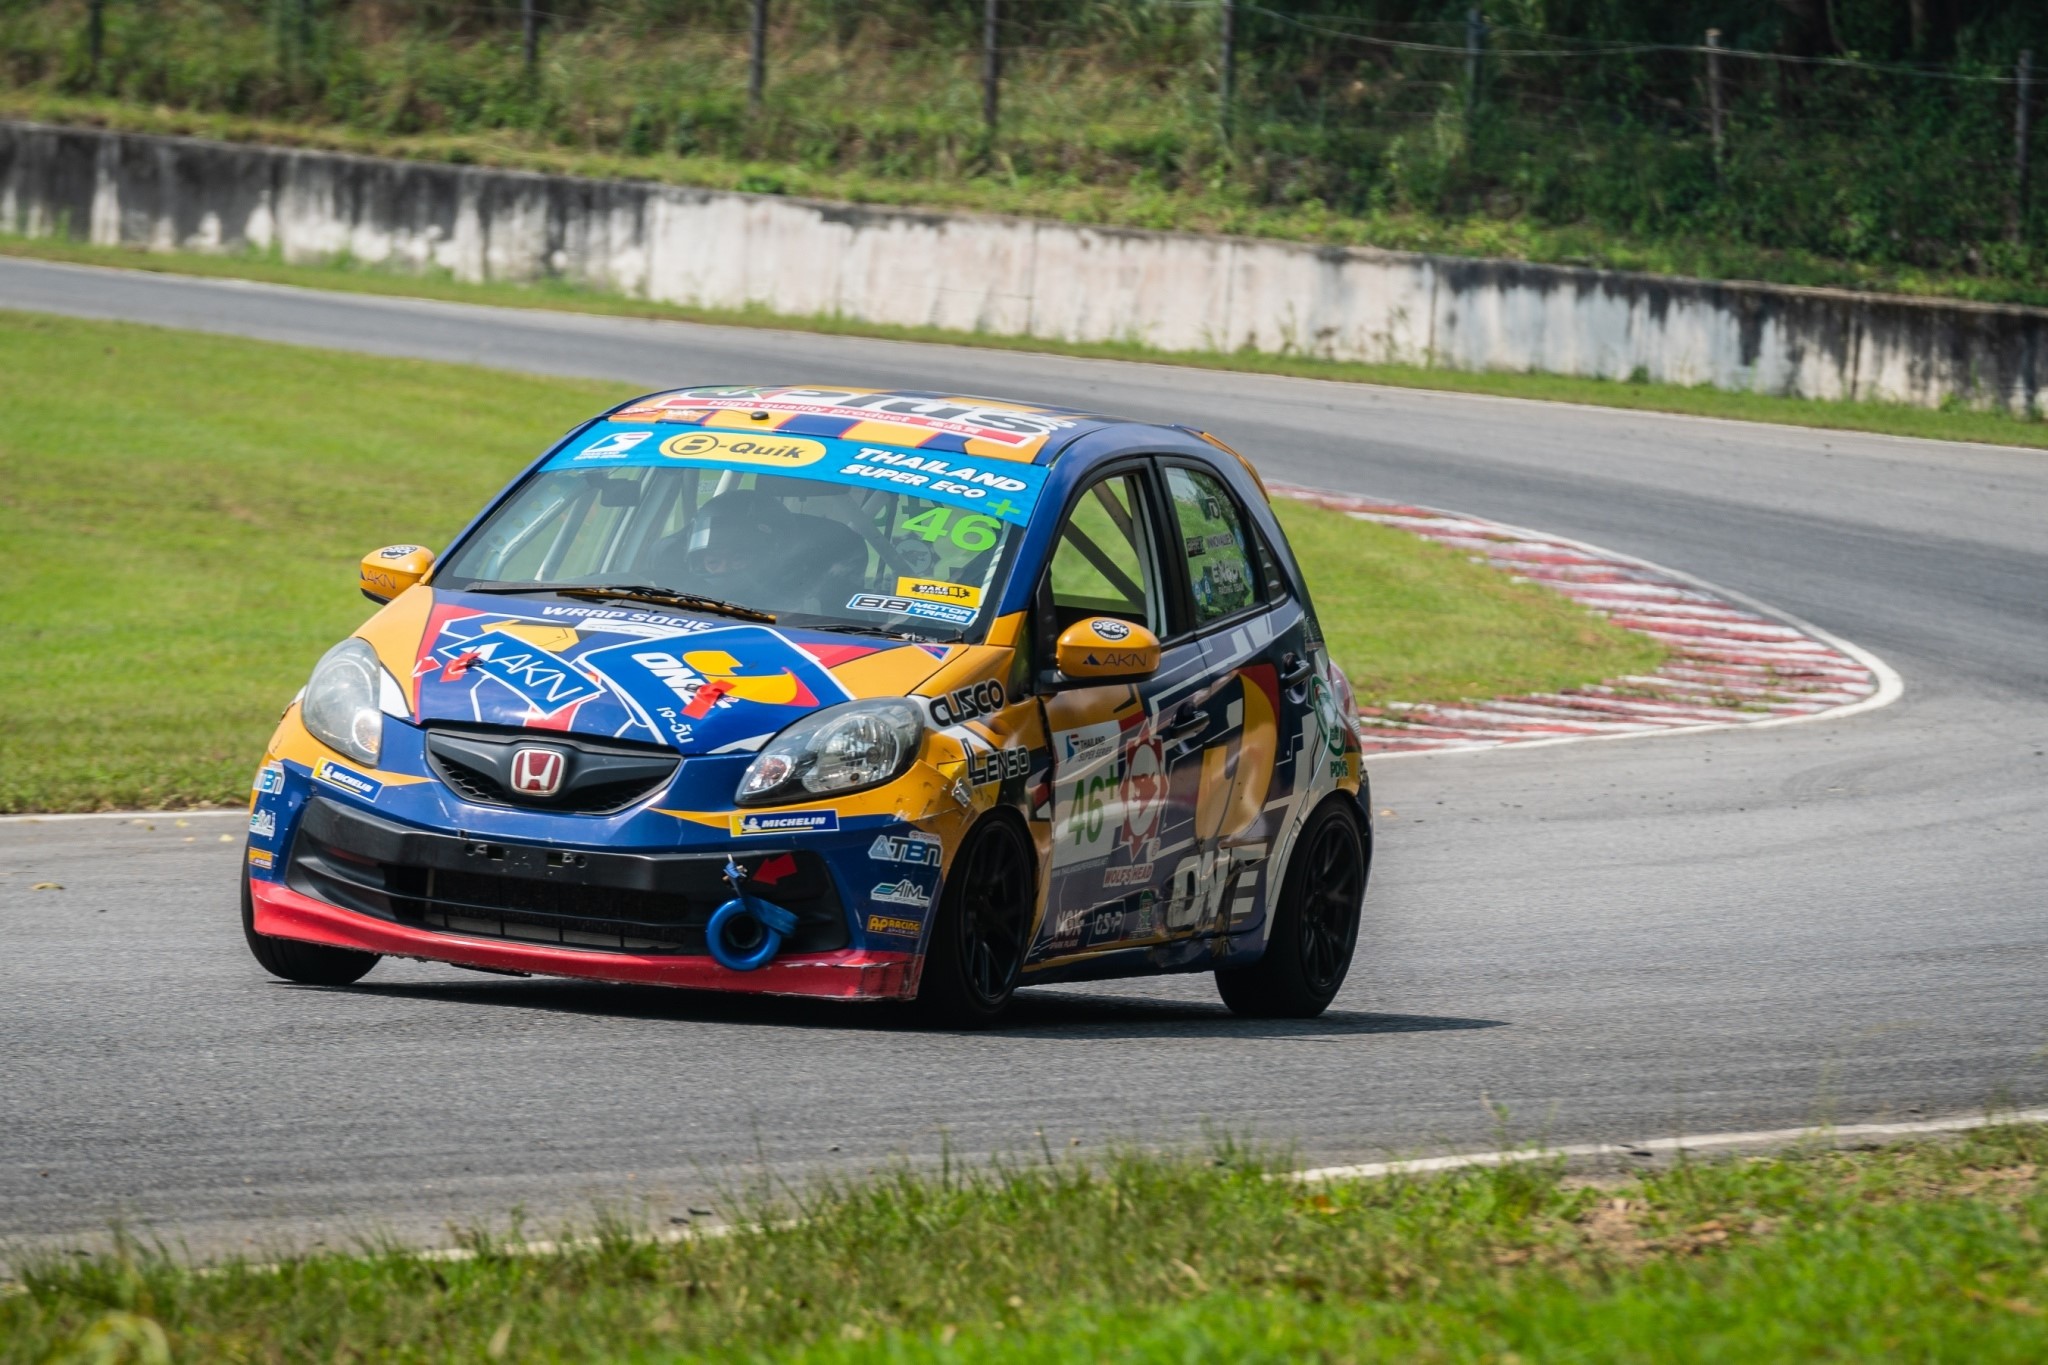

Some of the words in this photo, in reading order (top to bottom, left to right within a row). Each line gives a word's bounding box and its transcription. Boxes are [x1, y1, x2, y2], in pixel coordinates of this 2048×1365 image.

[707, 399, 755, 408] High
[760, 402, 825, 413] quality
[829, 407, 911, 422] product
[669, 434, 805, 459] B-Quik
[853, 447, 1027, 491] THAILAND
[840, 463, 930, 487] SUPER
[929, 480, 987, 498] ECO
[542, 606, 627, 619] WRAP
[914, 602, 972, 616] MOTOR
[914, 608, 967, 622] TRADE
[1103, 653, 1147, 667] AKN
[488, 653, 583, 702] AKN
[929, 678, 1005, 727] CUSCO
[961, 737, 1031, 786] LENSO
[332, 771, 374, 793] MICHELIN
[761, 816, 827, 828] MICHELIN
[869, 917, 888, 931] AP
